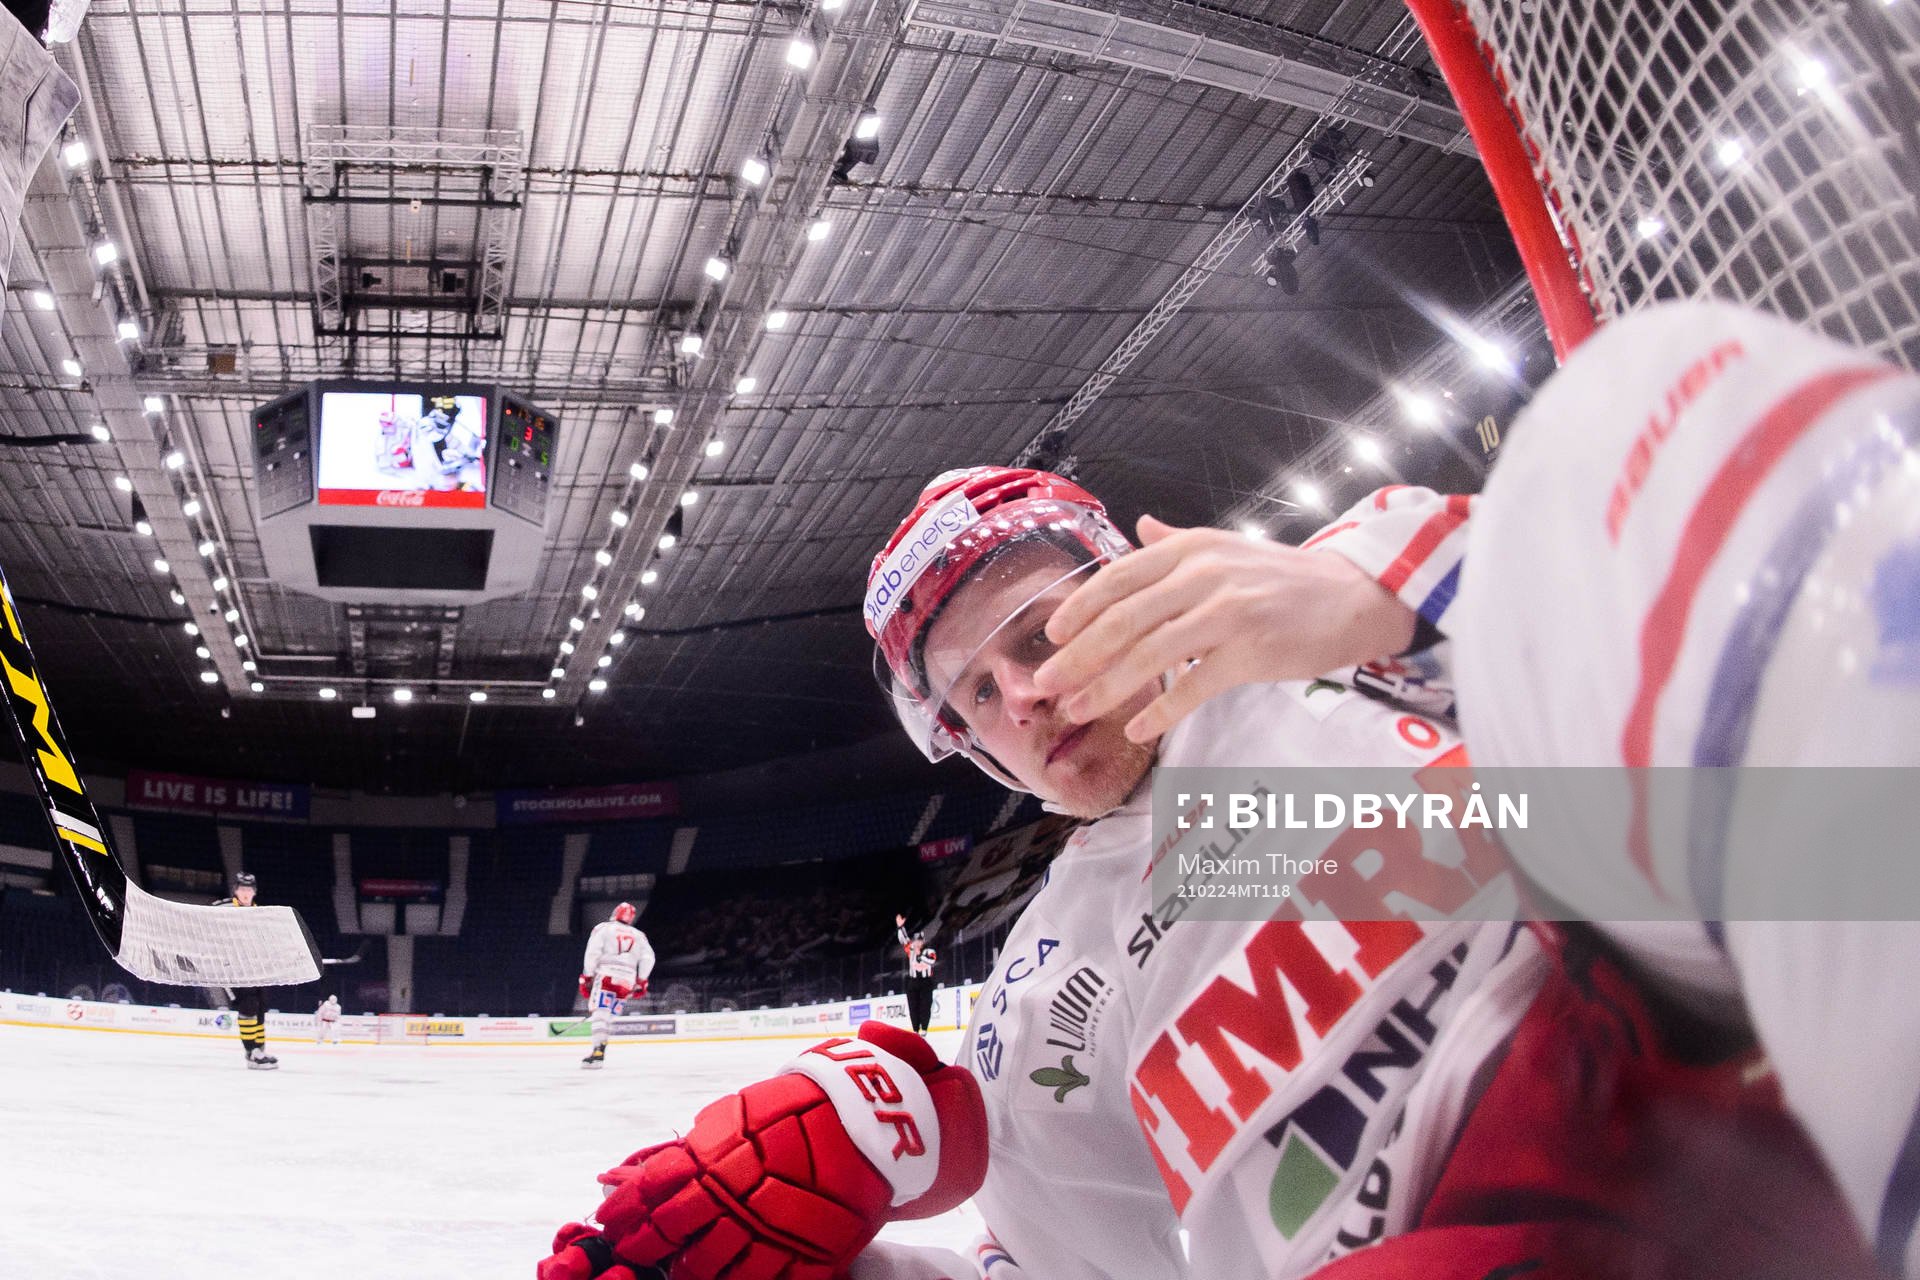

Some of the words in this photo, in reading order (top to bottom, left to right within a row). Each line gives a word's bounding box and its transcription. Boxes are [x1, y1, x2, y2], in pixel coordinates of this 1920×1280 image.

[1475, 414, 1500, 454] 10
[143, 779, 195, 802] LIVE
[204, 786, 227, 805] IS
[236, 788, 293, 810] LIFE!
[616, 934, 635, 956] 17
[992, 938, 1060, 1016] SCA
[799, 1037, 927, 1162] UER
